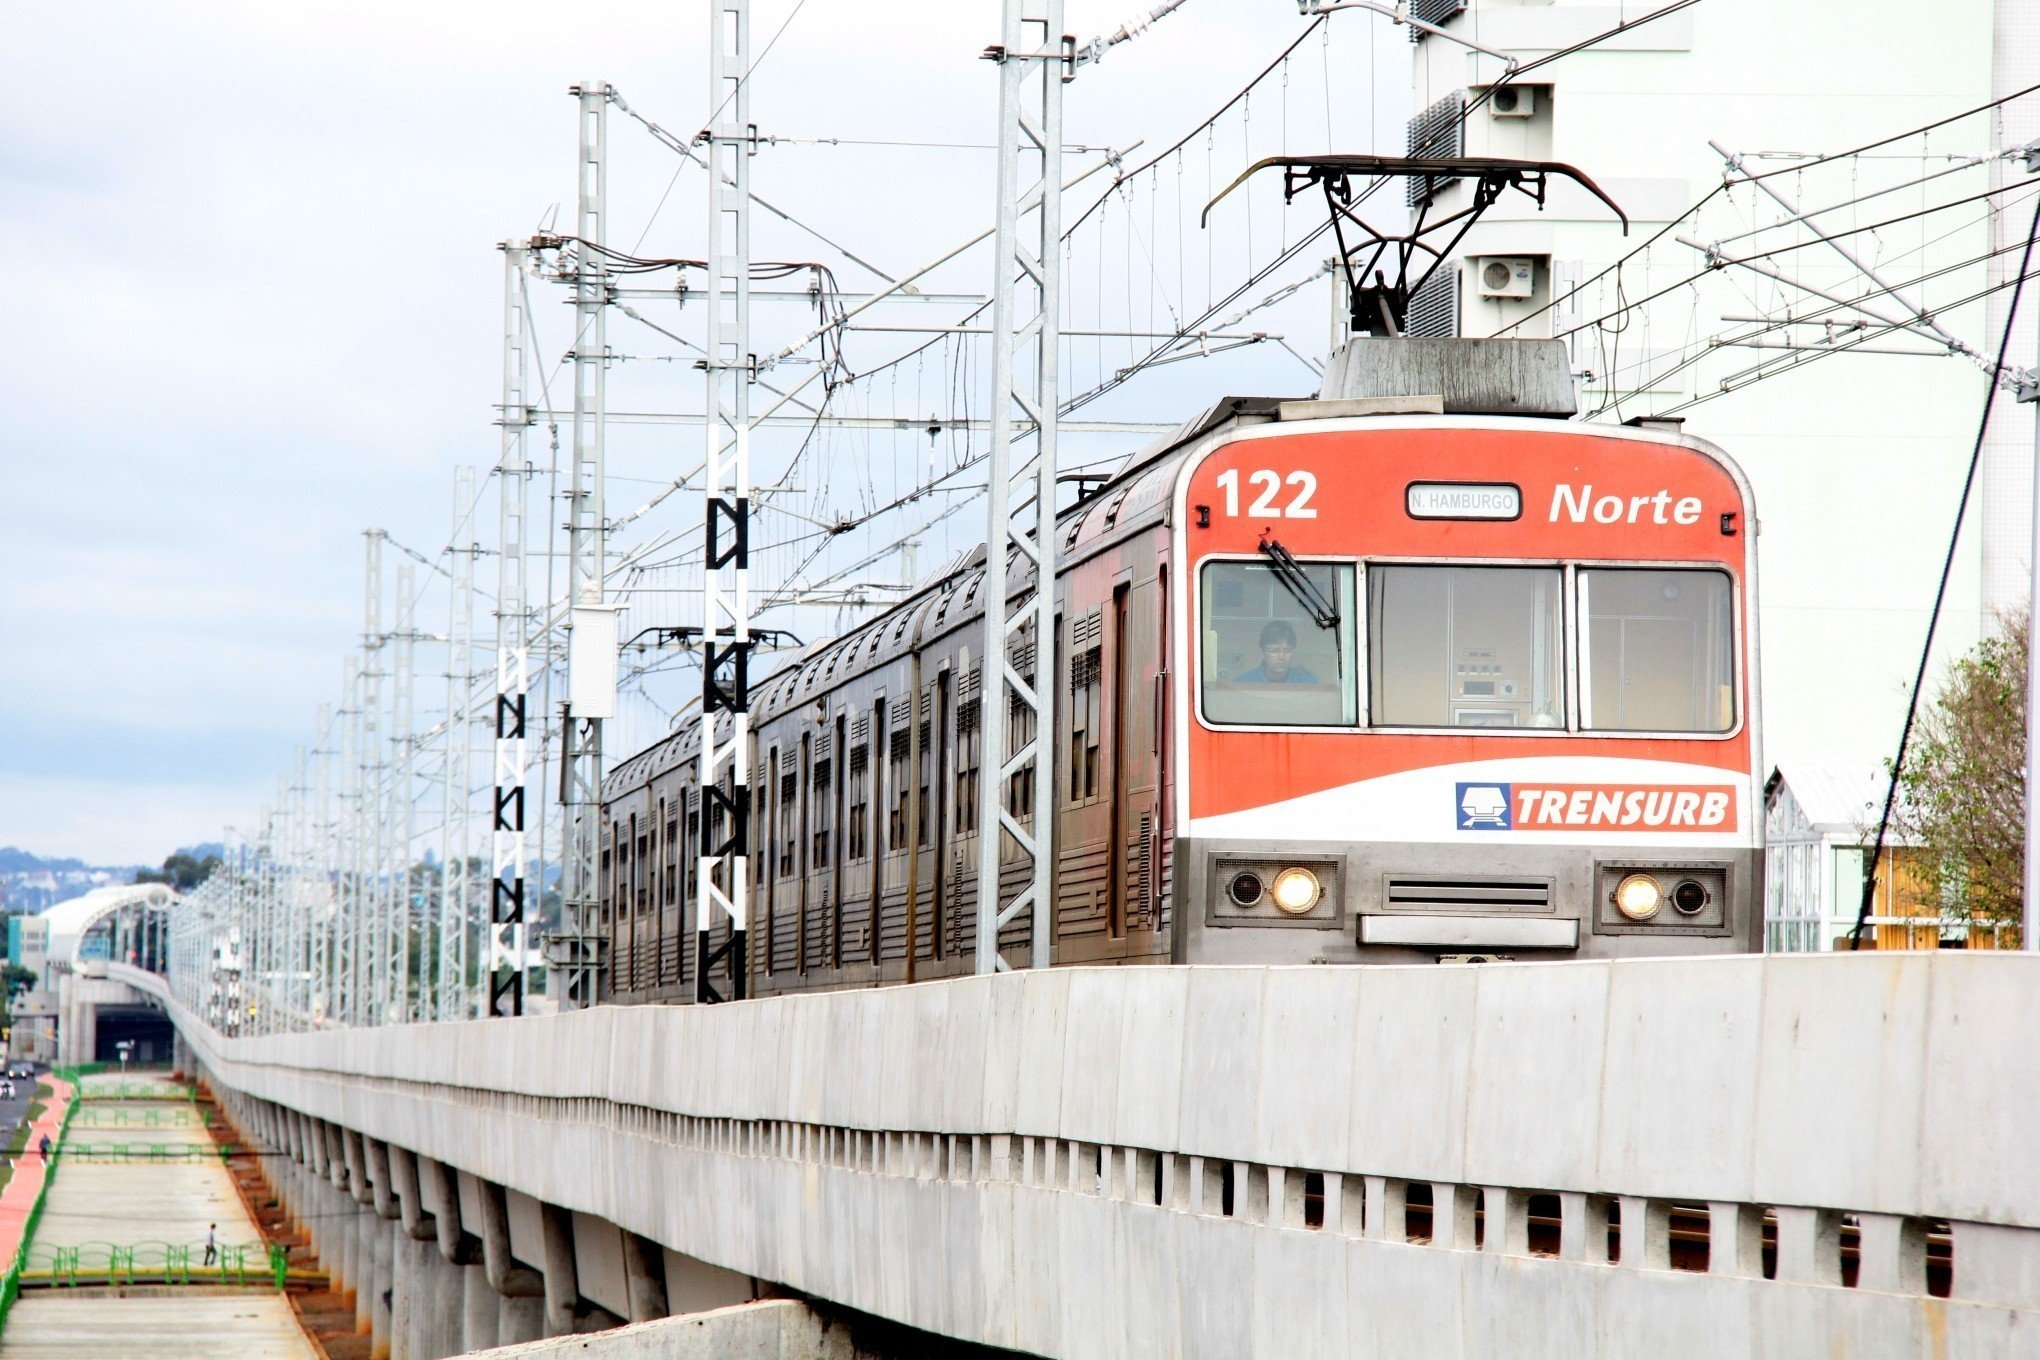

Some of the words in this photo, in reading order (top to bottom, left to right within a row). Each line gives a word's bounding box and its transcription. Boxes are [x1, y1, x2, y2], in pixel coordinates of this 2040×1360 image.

[1216, 468, 1318, 519] 122
[1411, 492, 1425, 508] N.
[1429, 493, 1514, 509] HAMBURGO
[1548, 484, 1702, 525] Norte
[1517, 790, 1730, 826] TRENSURB
